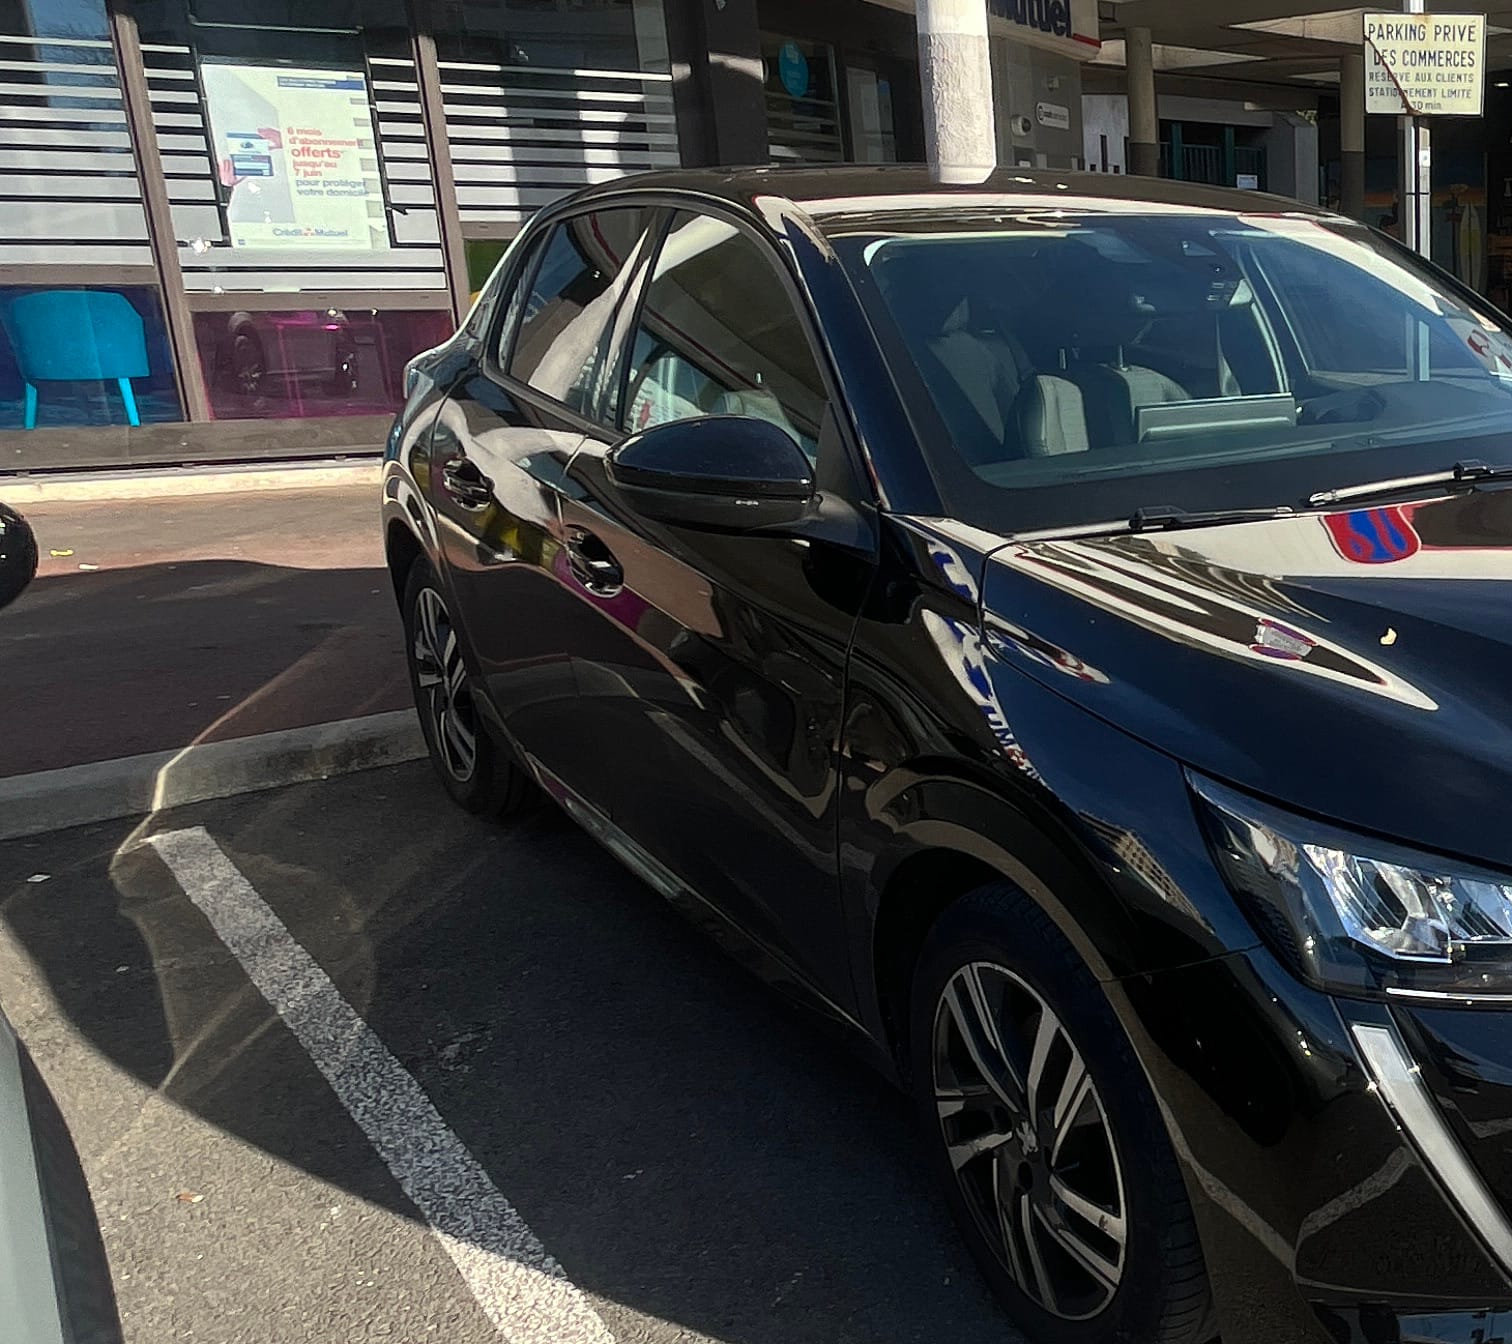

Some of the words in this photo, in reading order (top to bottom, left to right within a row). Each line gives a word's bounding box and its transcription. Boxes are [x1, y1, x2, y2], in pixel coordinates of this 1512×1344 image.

[1368, 23, 1427, 41] PARKING
[1373, 49, 1397, 66] DES
[1402, 50, 1476, 67] COMMERCES
[1414, 72, 1433, 83] AUX
[1435, 72, 1475, 84] CLIENTS
[1368, 87, 1438, 98] STATIOEMENT
[291, 146, 341, 159] offerts
